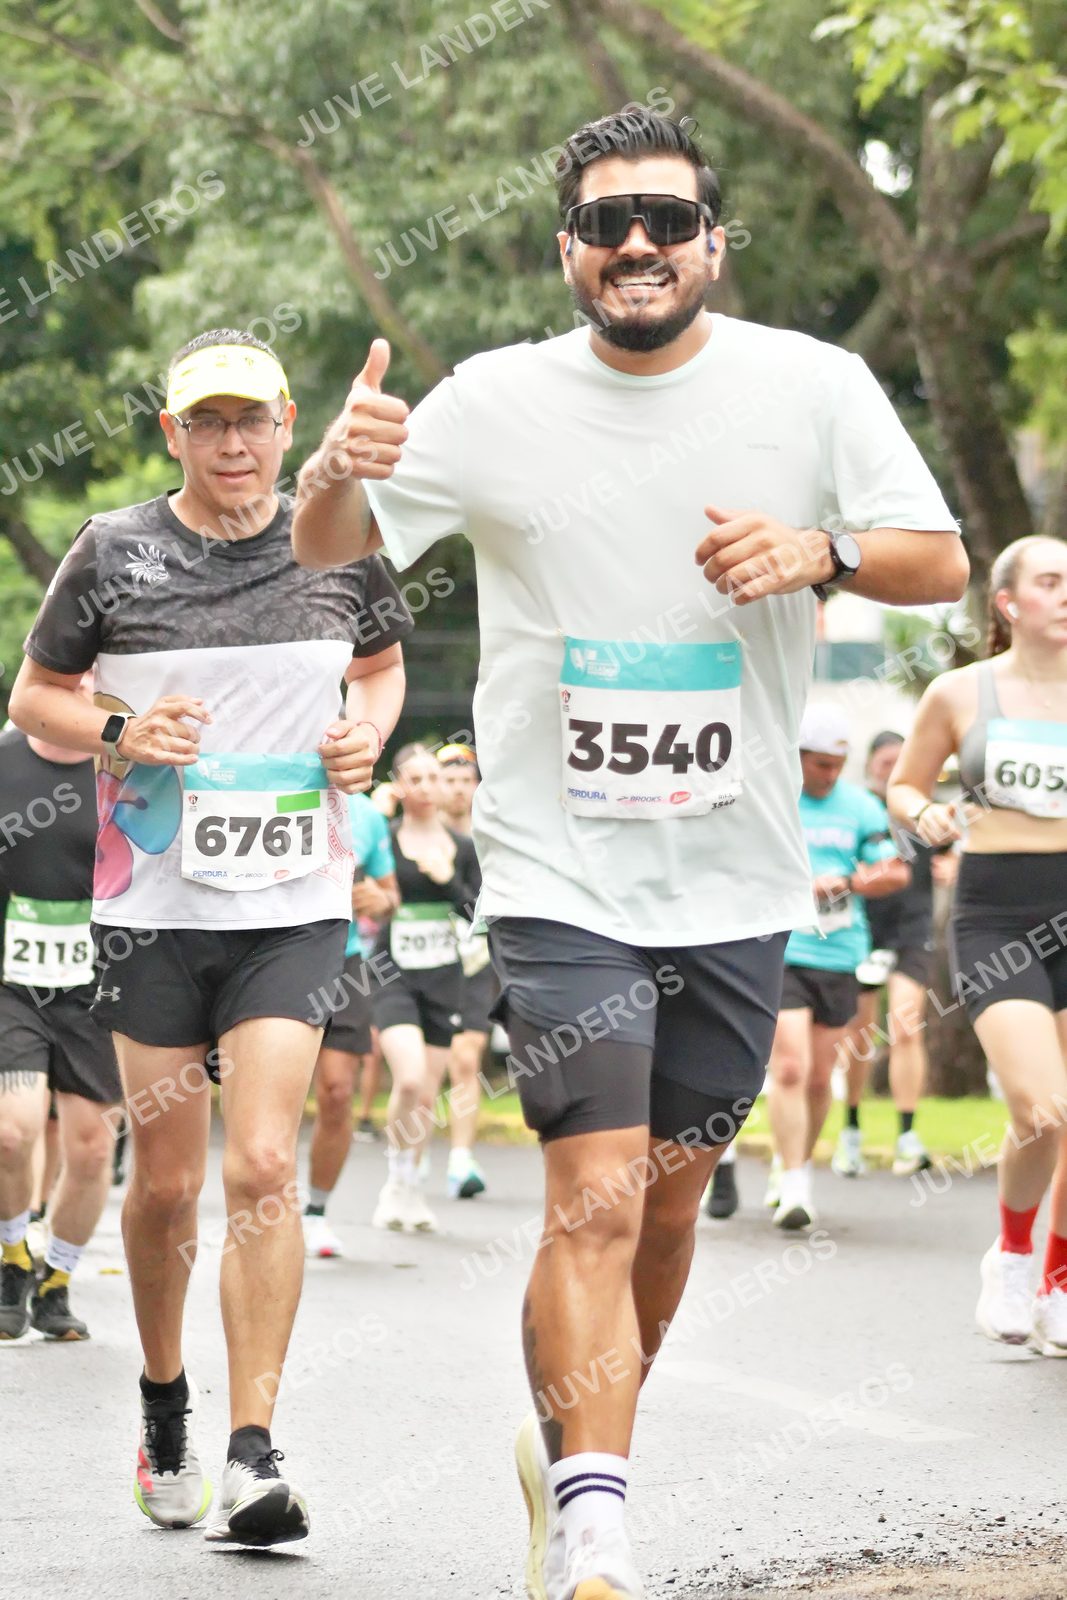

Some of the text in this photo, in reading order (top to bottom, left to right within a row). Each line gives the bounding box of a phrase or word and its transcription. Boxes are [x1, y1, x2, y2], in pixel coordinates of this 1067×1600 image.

[567, 718, 732, 776] 3540
[995, 760, 1067, 793] 605
[567, 787, 607, 801] PERDURA
[195, 815, 313, 857] 6761
[192, 870, 228, 878] PERDURA
[12, 939, 88, 964] 2118
